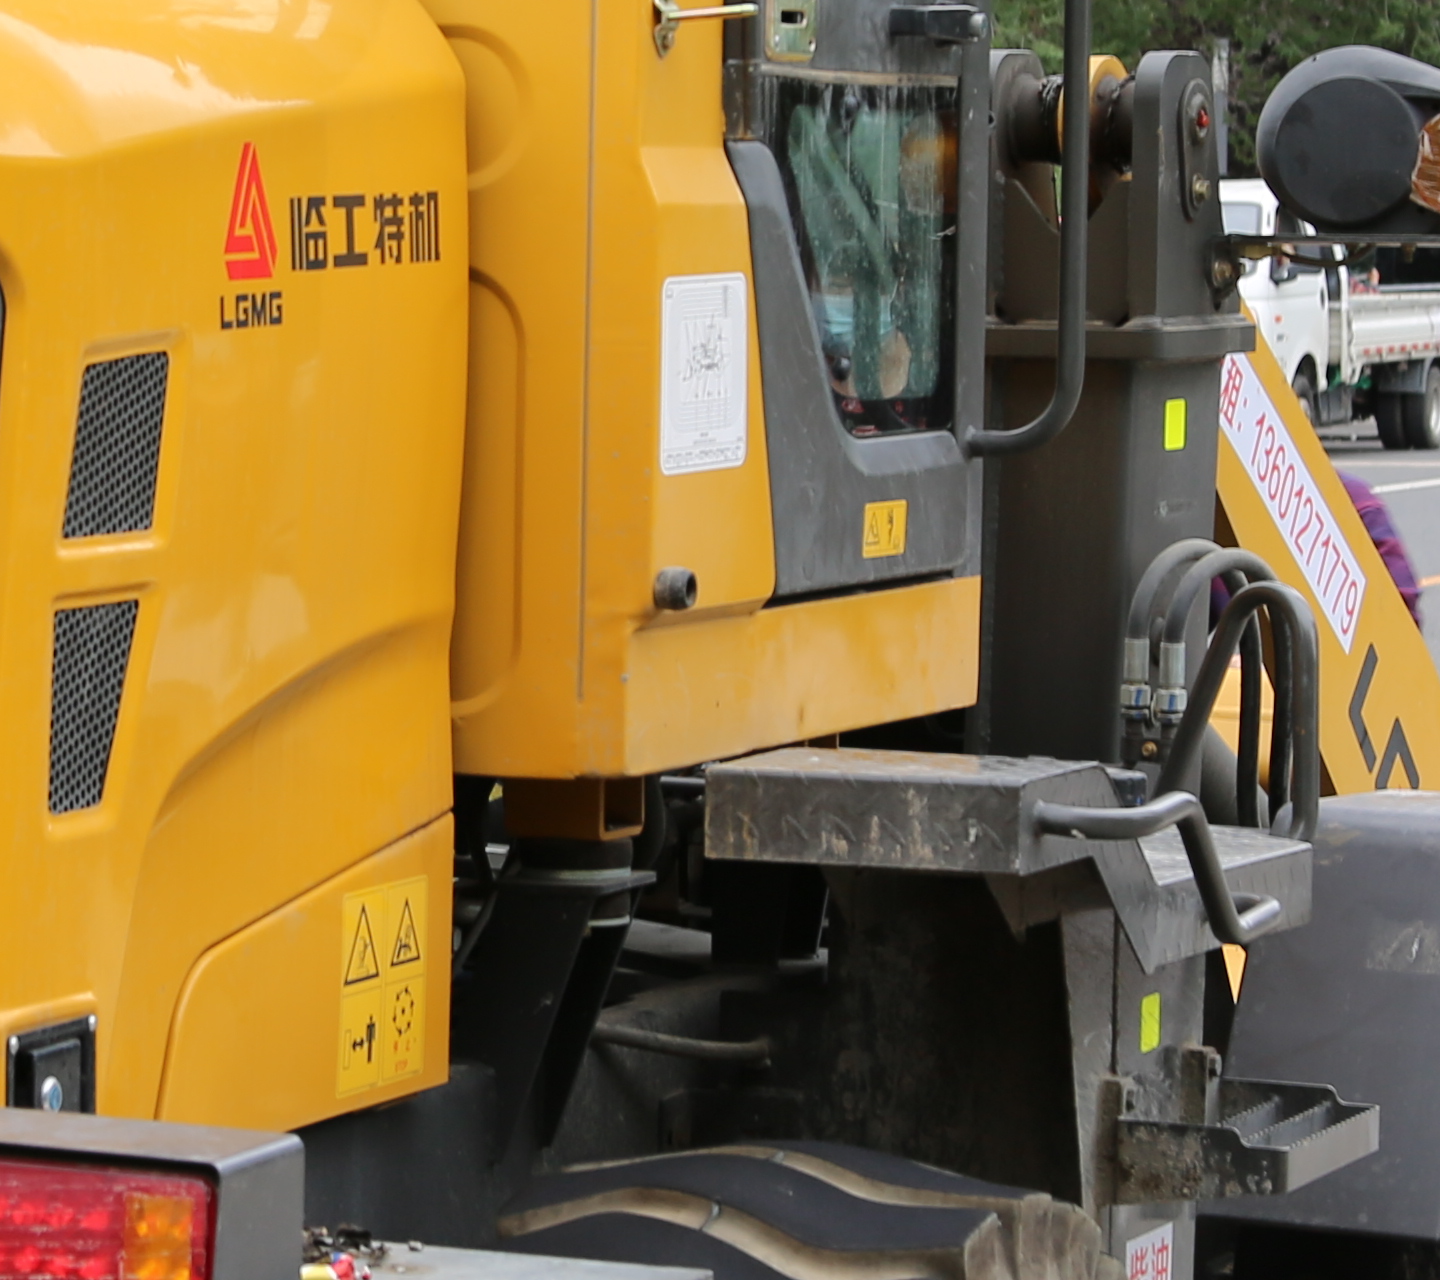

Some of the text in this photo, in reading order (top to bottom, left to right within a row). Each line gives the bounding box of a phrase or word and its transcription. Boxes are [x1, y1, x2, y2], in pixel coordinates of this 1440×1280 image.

[289, 191, 441, 272] 临工特机
[219, 289, 283, 331] LGMG
[1251, 411, 1358, 636] 13601271779
